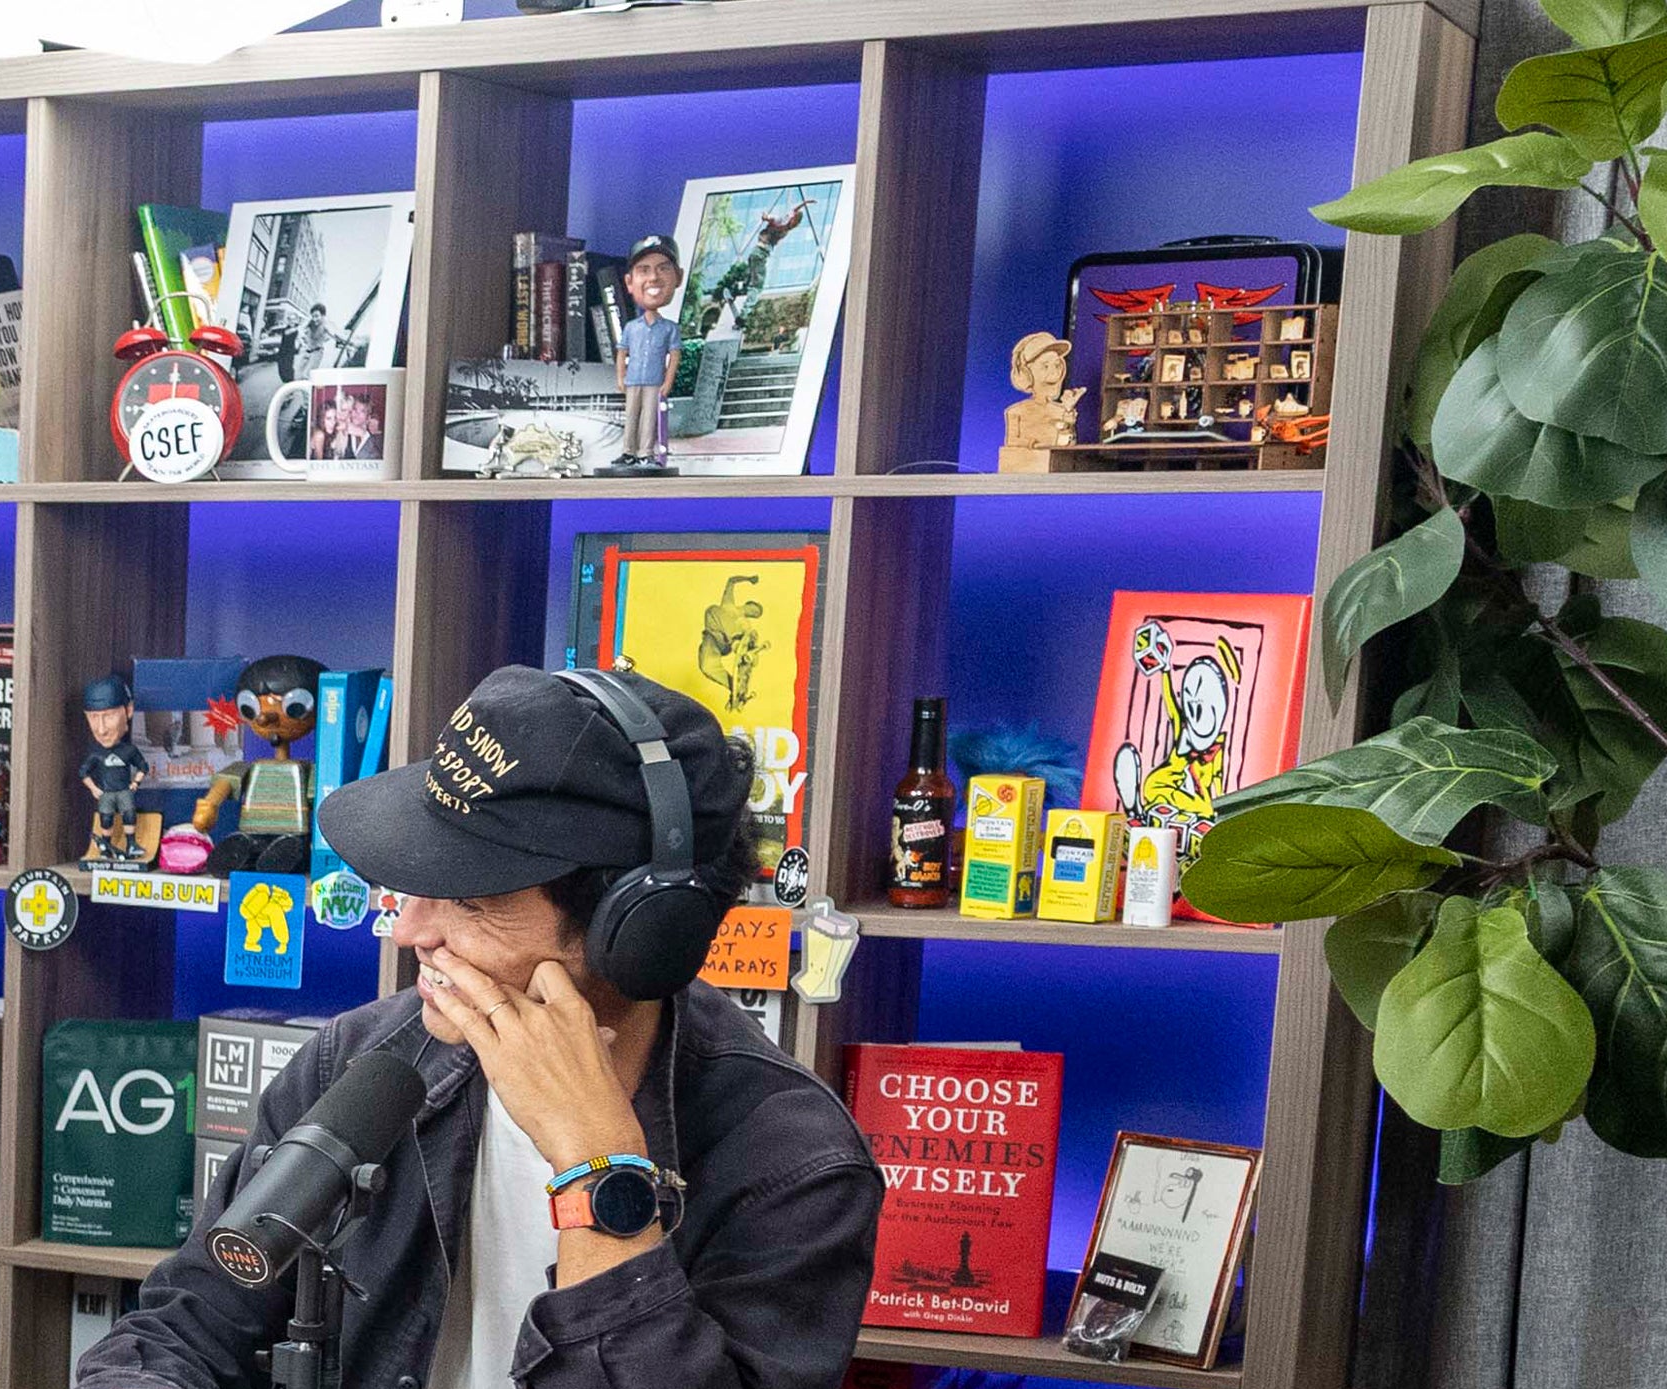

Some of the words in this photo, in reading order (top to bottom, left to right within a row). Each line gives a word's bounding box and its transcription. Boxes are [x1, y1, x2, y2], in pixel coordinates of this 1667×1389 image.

[141, 422, 204, 461] CSEF
[466, 726, 519, 778] SNOW
[438, 750, 494, 799] SPORT
[11, 866, 70, 898] MOUNTAIN
[98, 876, 215, 905] MTN.BUM
[11, 922, 69, 947] PATROL
[234, 953, 294, 968] MTN.BUM
[878, 1073, 1040, 1108] CHOOSE
[902, 1104, 1009, 1136] YOUR
[868, 1134, 1046, 1169] ENEMIES
[53, 1172, 115, 1187] Comprehensive
[60, 1185, 106, 1198] Convenient
[878, 1162, 1027, 1199] WISELY
[53, 1194, 75, 1209] Daily
[75, 1196, 113, 1209] Nutrition
[220, 1243, 252, 1254] THE
[220, 1250, 260, 1266] NINE
[228, 1262, 260, 1273] CLUB
[1094, 1272, 1117, 1287] NUTS
[1123, 1280, 1147, 1296] BOLTS
[870, 1289, 925, 1308] Patrick
[931, 1295, 1010, 1315] Bet-David
[923, 1311, 945, 1323] Greg
